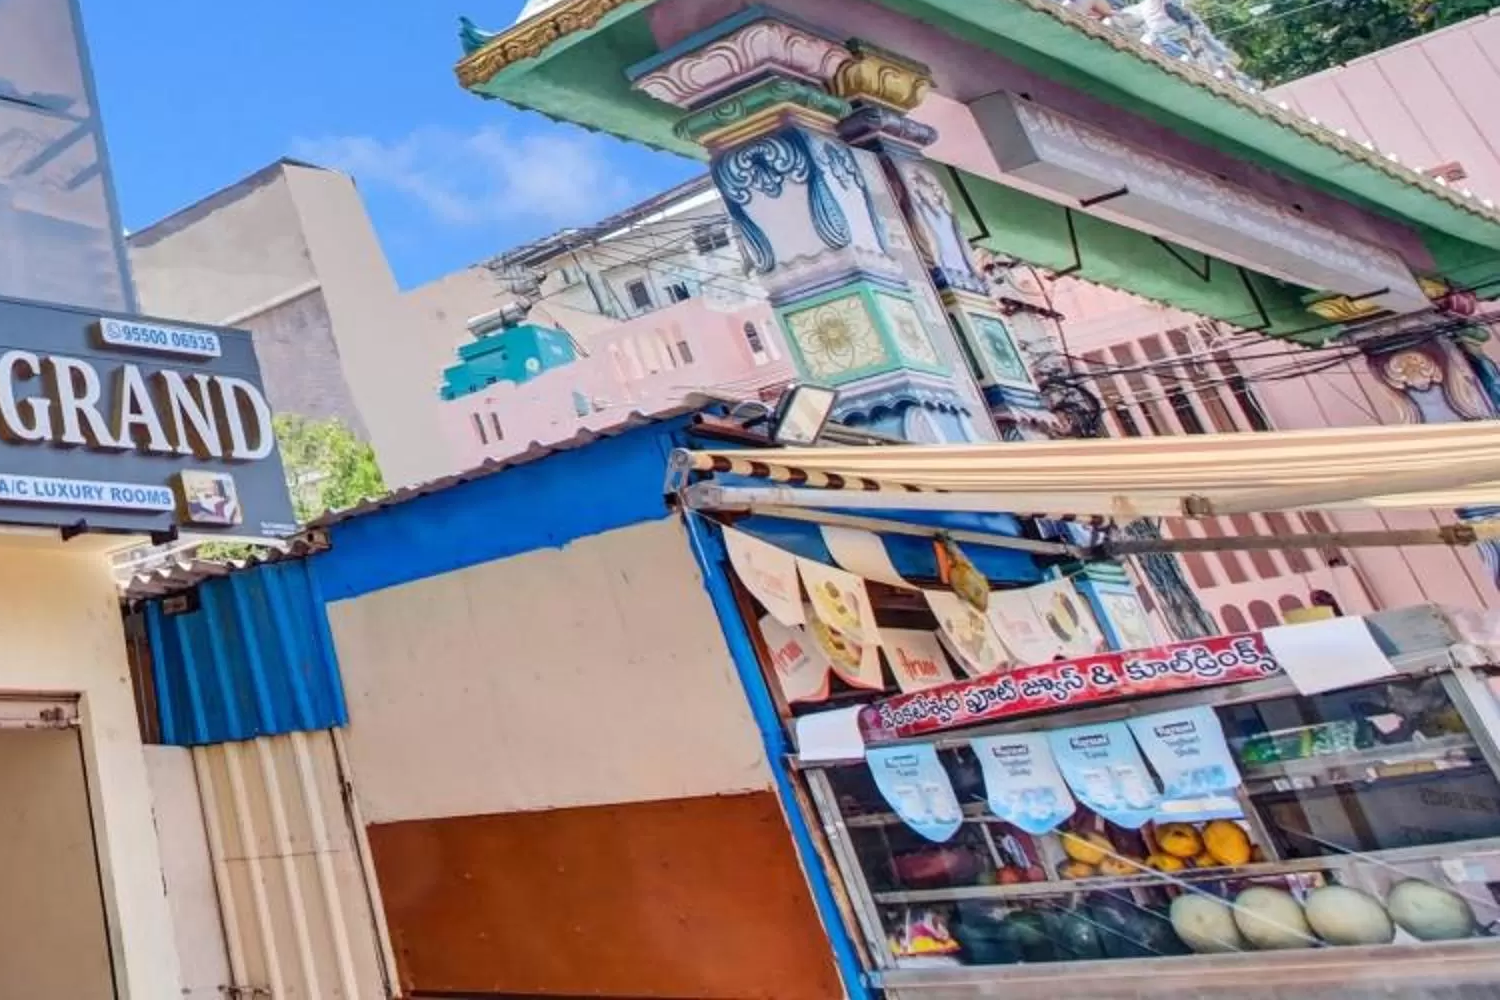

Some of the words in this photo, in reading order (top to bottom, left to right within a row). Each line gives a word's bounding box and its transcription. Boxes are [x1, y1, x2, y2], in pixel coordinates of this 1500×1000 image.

[122, 325, 168, 345] 95500
[171, 331, 216, 351] 06935
[33, 480, 104, 502] LUXURY
[110, 486, 172, 506] ROOMS
[1091, 665, 1118, 685] &
